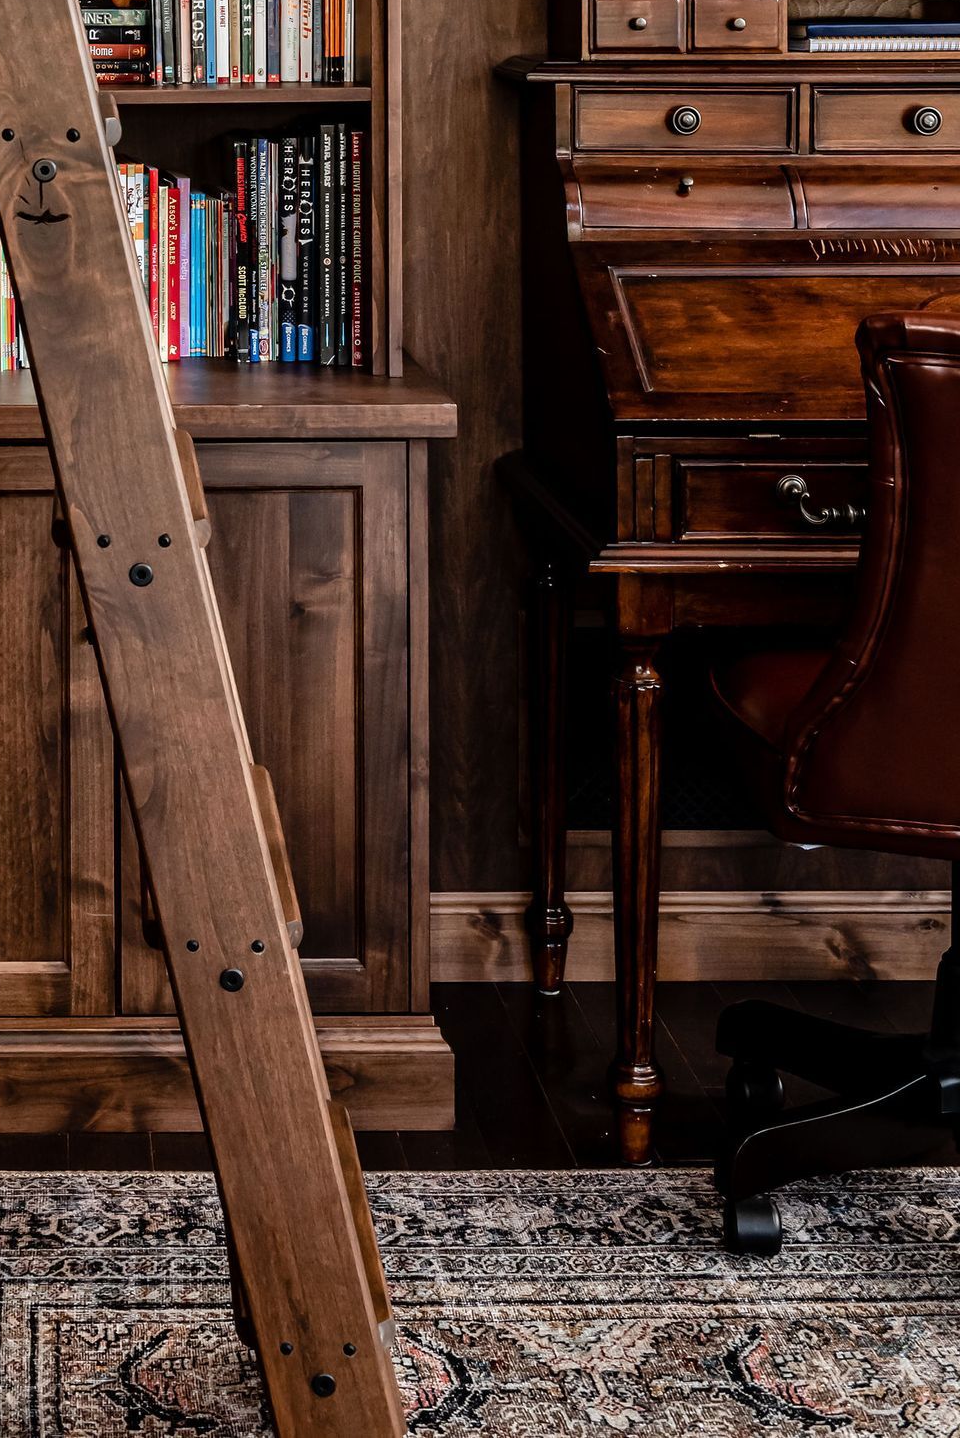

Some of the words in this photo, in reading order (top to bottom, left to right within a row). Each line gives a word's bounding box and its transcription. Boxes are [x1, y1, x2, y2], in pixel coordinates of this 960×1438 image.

[89, 46, 113, 56] Home
[237, 157, 245, 211] UNDERSTANDING
[282, 145, 296, 211] HEROES
[169, 197, 177, 231] AESOP'S
[298, 169, 314, 234] HEROES
[237, 213, 247, 242] COMICS
[169, 234, 177, 265] FABLES
[180, 258, 189, 280] Poetry
[238, 266, 246, 285] SCOTT
[238, 287, 246, 319] McCLOUD
